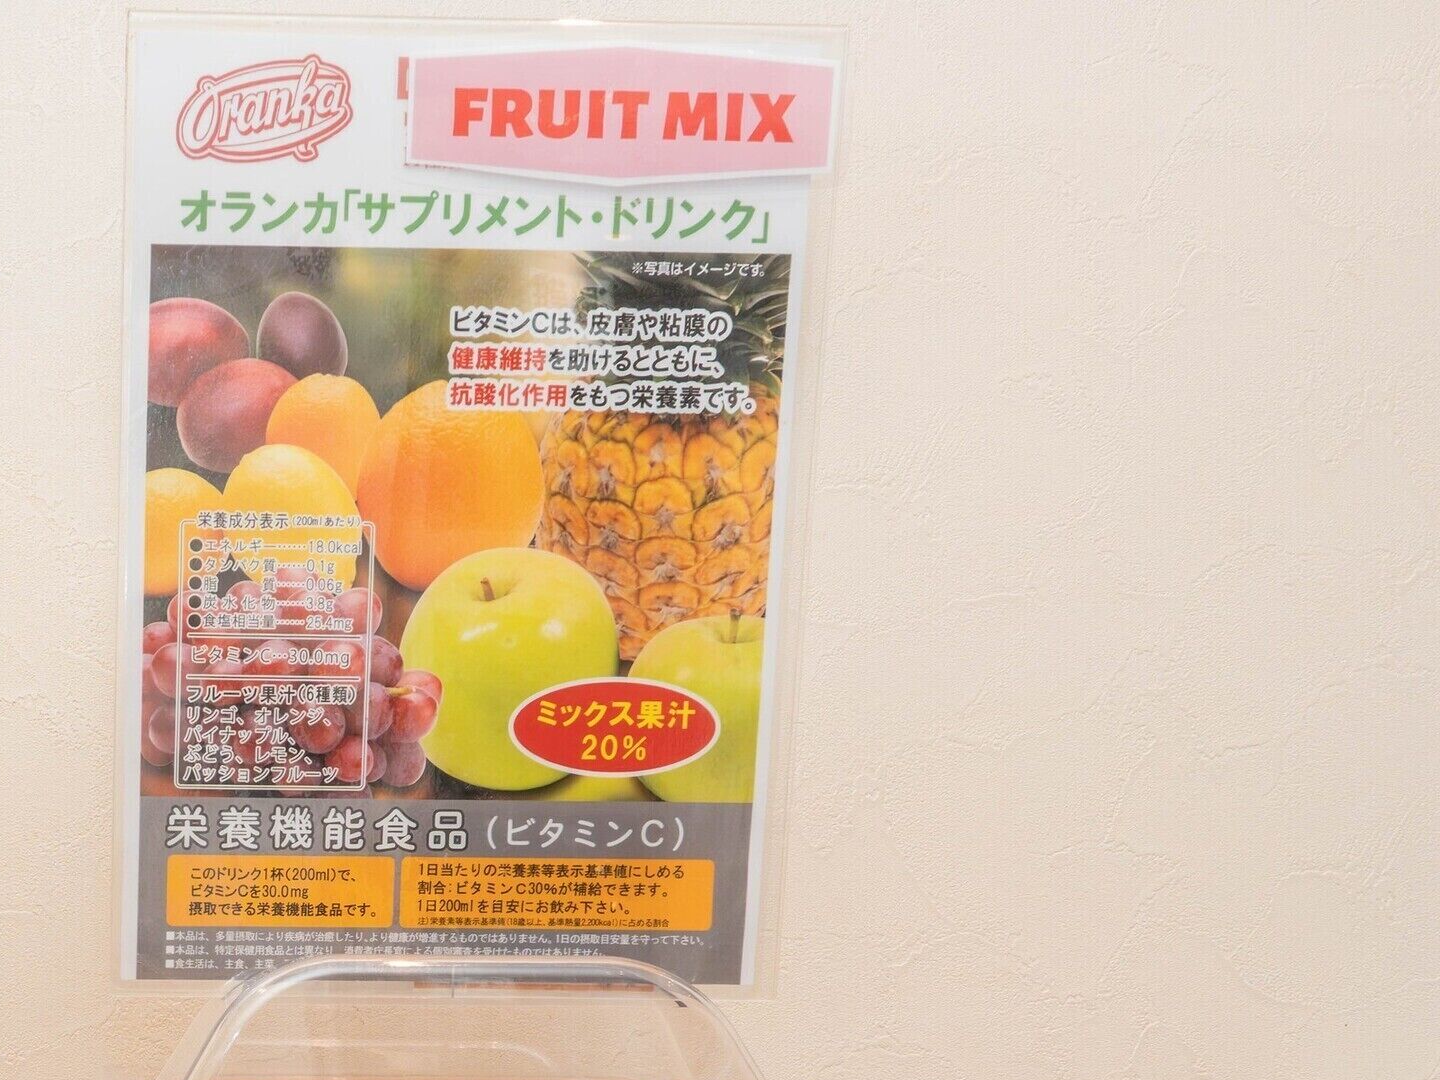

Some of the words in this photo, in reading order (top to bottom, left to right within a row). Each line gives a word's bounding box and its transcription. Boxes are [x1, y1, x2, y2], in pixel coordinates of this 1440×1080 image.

[179, 58, 349, 159] Oranka
[451, 87, 650, 142] FRUIT
[663, 91, 796, 144] MIX
[179, 189, 770, 244] オランカ「サプリメント・ドリンク」
[452, 310, 728, 337] ビタミンCは、皮膚や粘膜の
[450, 382, 756, 411] 抗酸化作用をもつ栄養素です。
[536, 699, 697, 730] ミックス果汁
[580, 734, 648, 761] 20%
[183, 764, 339, 783] パッションフルーツ
